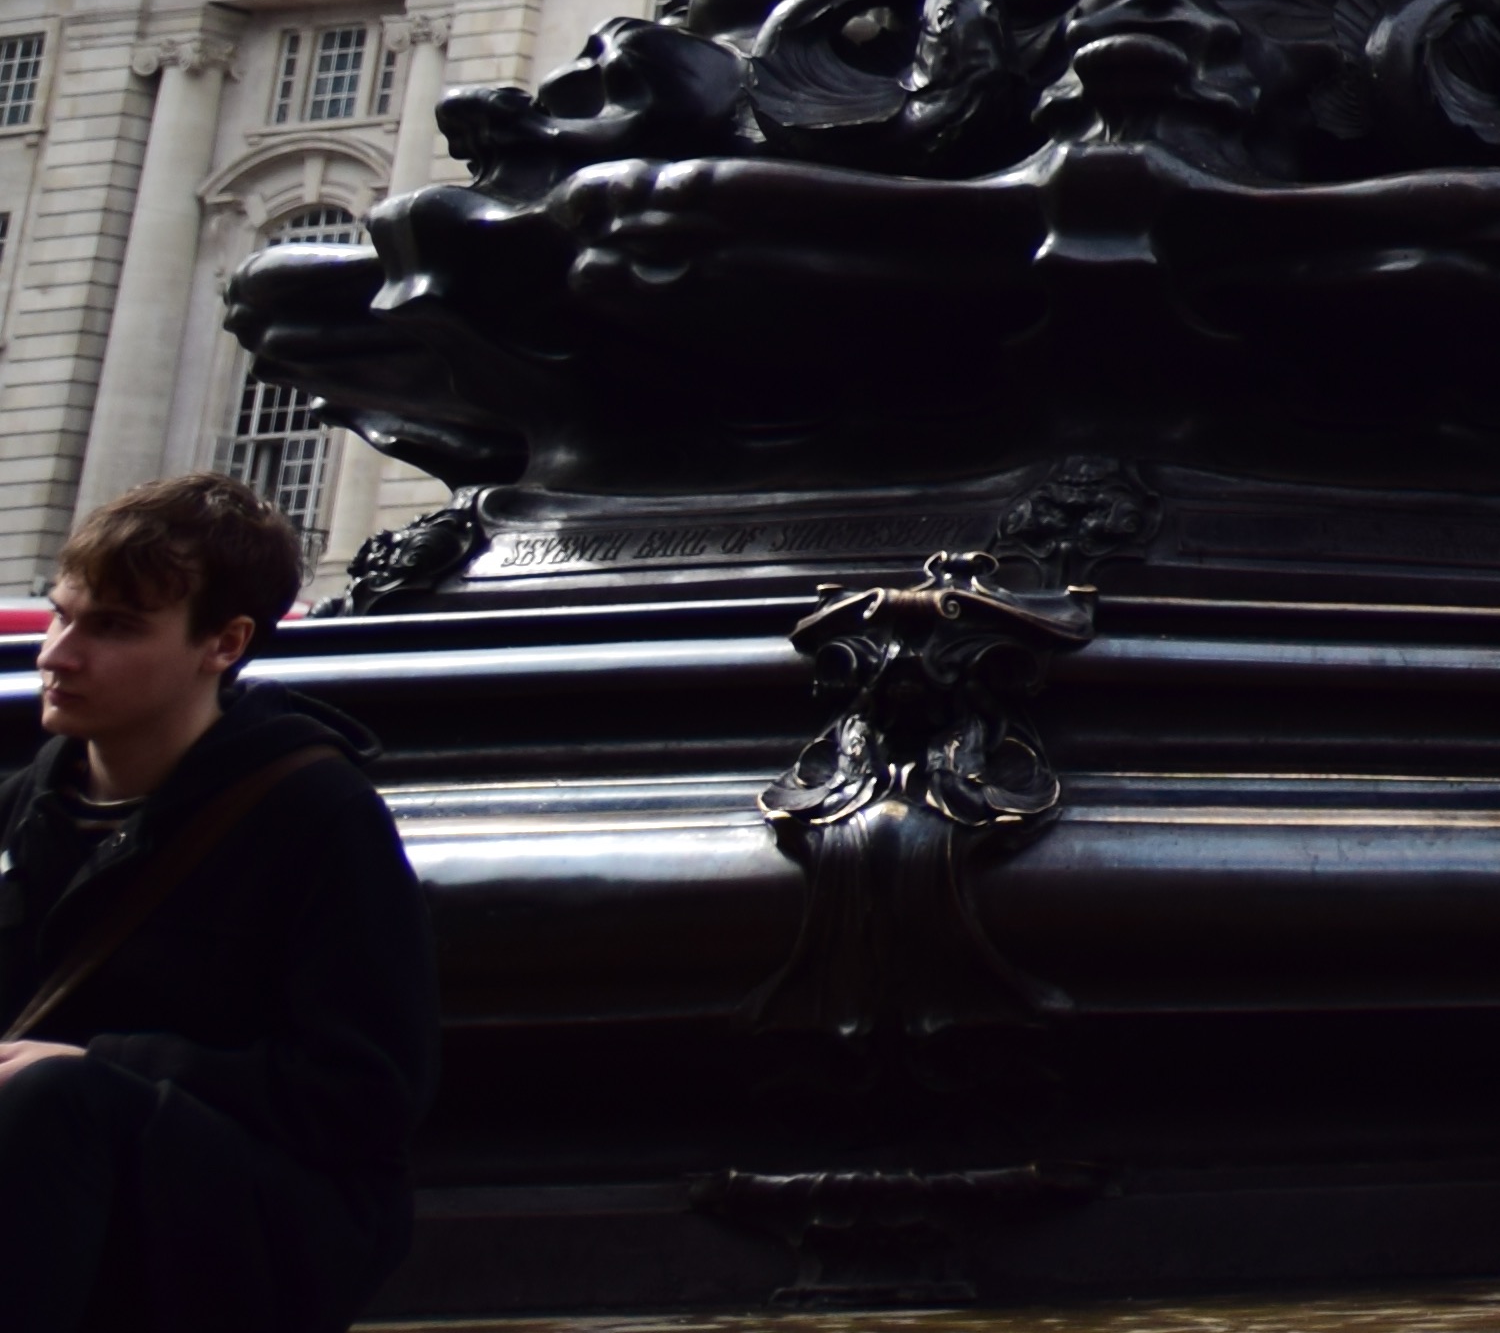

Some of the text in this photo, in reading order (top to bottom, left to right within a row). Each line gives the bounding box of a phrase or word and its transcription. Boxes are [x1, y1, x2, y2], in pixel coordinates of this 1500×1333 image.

[500, 530, 633, 568] SEVENTH
[633, 527, 711, 560] EARL
[721, 526, 766, 554] OF
